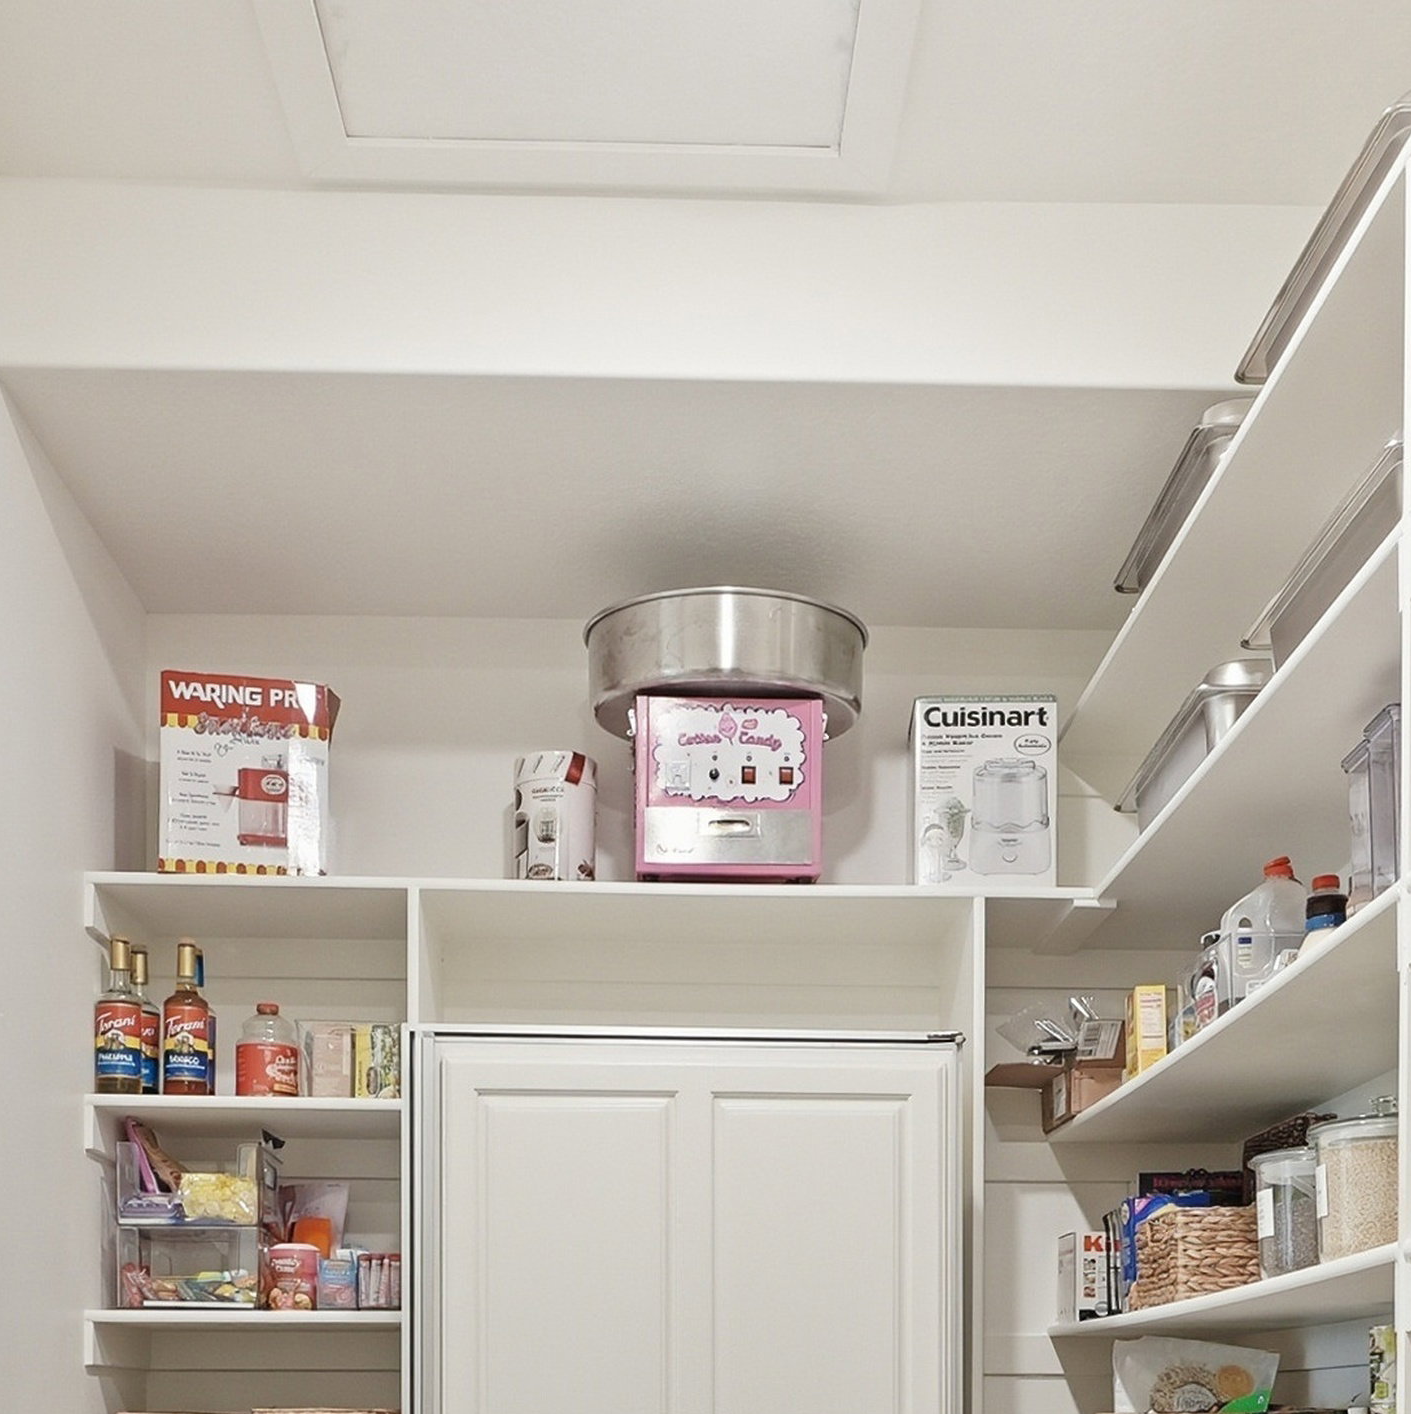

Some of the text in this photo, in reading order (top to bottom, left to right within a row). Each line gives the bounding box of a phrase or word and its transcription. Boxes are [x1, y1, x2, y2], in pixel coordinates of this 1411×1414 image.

[168, 680, 301, 709] WARING PR
[923, 706, 1048, 728] Cuisinart
[739, 731, 783, 752] Candy
[96, 1012, 136, 1035] Torani
[165, 1015, 206, 1039] Torani
